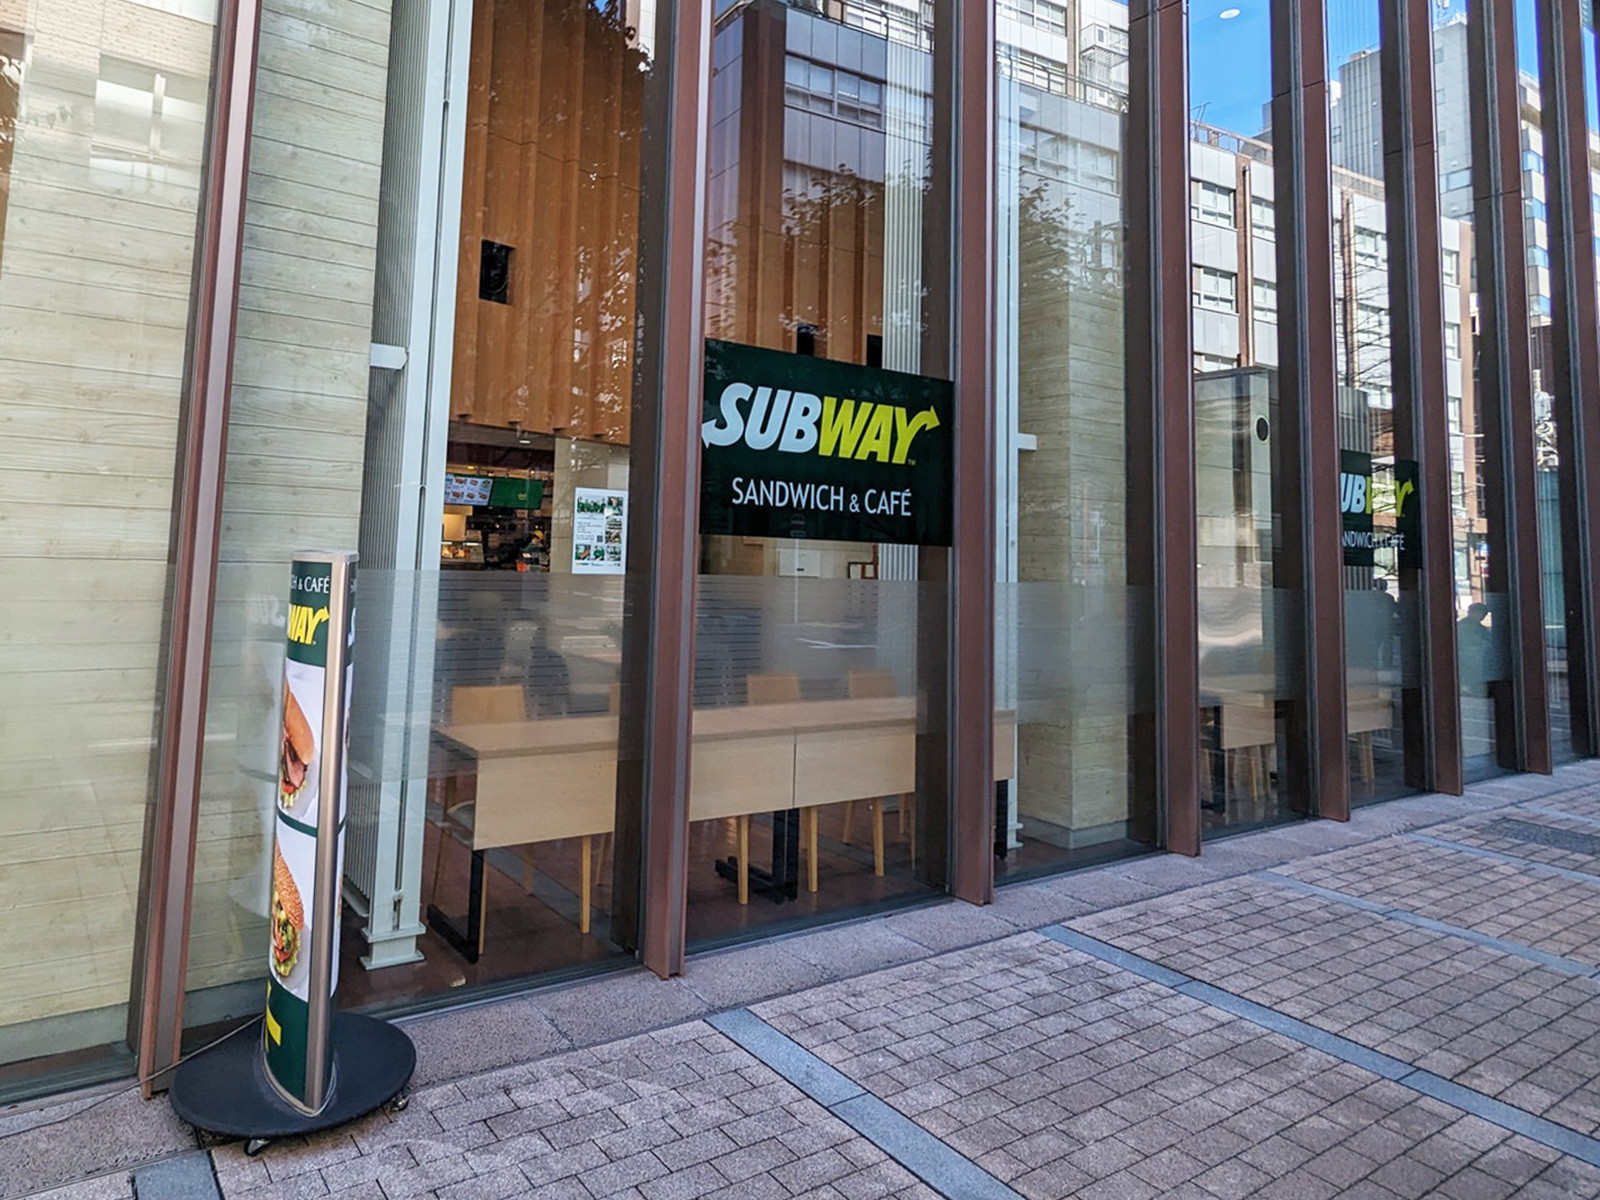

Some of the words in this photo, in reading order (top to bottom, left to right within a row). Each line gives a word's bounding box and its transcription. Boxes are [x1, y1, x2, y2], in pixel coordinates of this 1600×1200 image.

[702, 382, 940, 464] SUBWAY
[731, 477, 844, 512] SANDWICH
[849, 494, 861, 513] &
[864, 488, 912, 516] CAFÉ
[304, 575, 330, 594] CAFÉ
